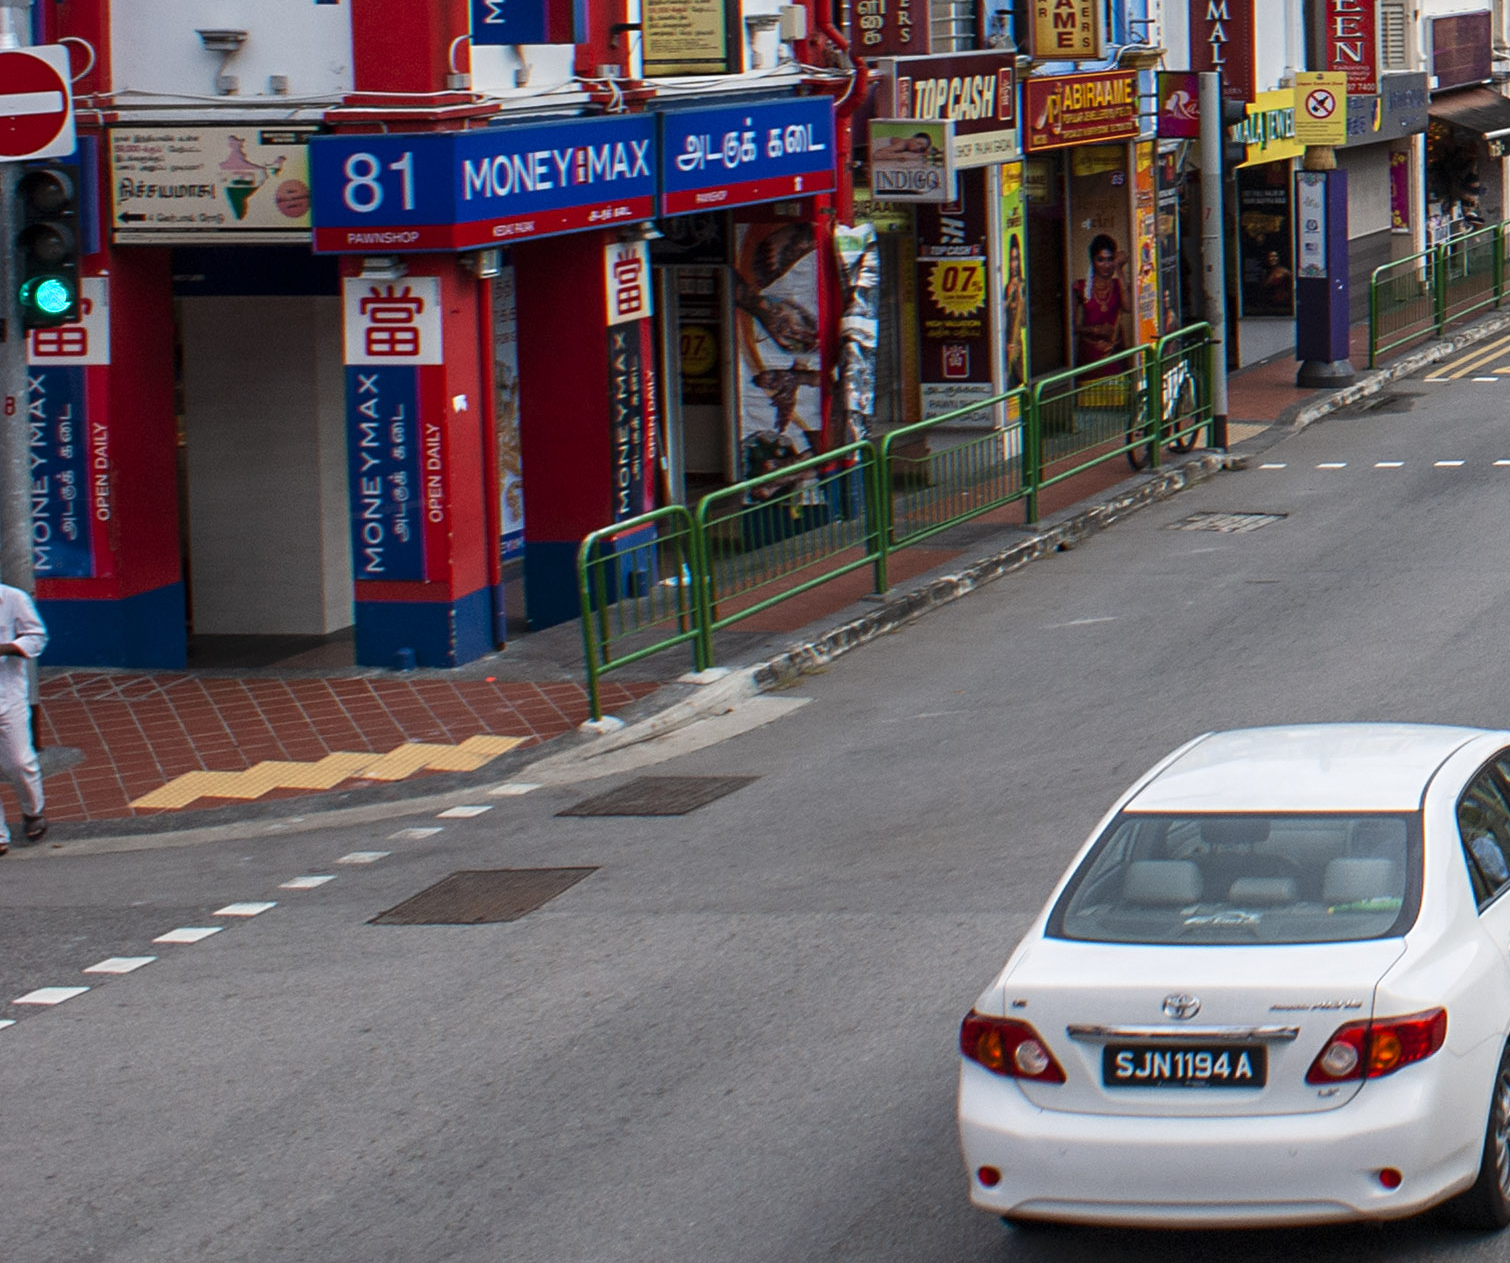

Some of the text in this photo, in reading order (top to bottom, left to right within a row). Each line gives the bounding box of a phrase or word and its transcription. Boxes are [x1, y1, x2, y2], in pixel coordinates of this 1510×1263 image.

[914, 78, 949, 120] TOP
[949, 74, 997, 120] CASH
[1063, 78, 1133, 111] ABIRAAME
[676, 118, 825, 172] அடகுக் கடை
[343, 152, 416, 213] 81
[876, 169, 941, 188] INDIGO
[346, 231, 420, 246] PAWNSHOP
[614, 331, 629, 514] MONEYMAX
[645, 369, 656, 459] OPEN DAILY
[29, 374, 52, 572] MONEYMAX
[92, 422, 110, 522] OPEN DAILY
[358, 373, 384, 574] MONEYMAX
[425, 422, 444, 523] OPEN DAILY
[1114, 1051, 1253, 1079] SJN1194A
